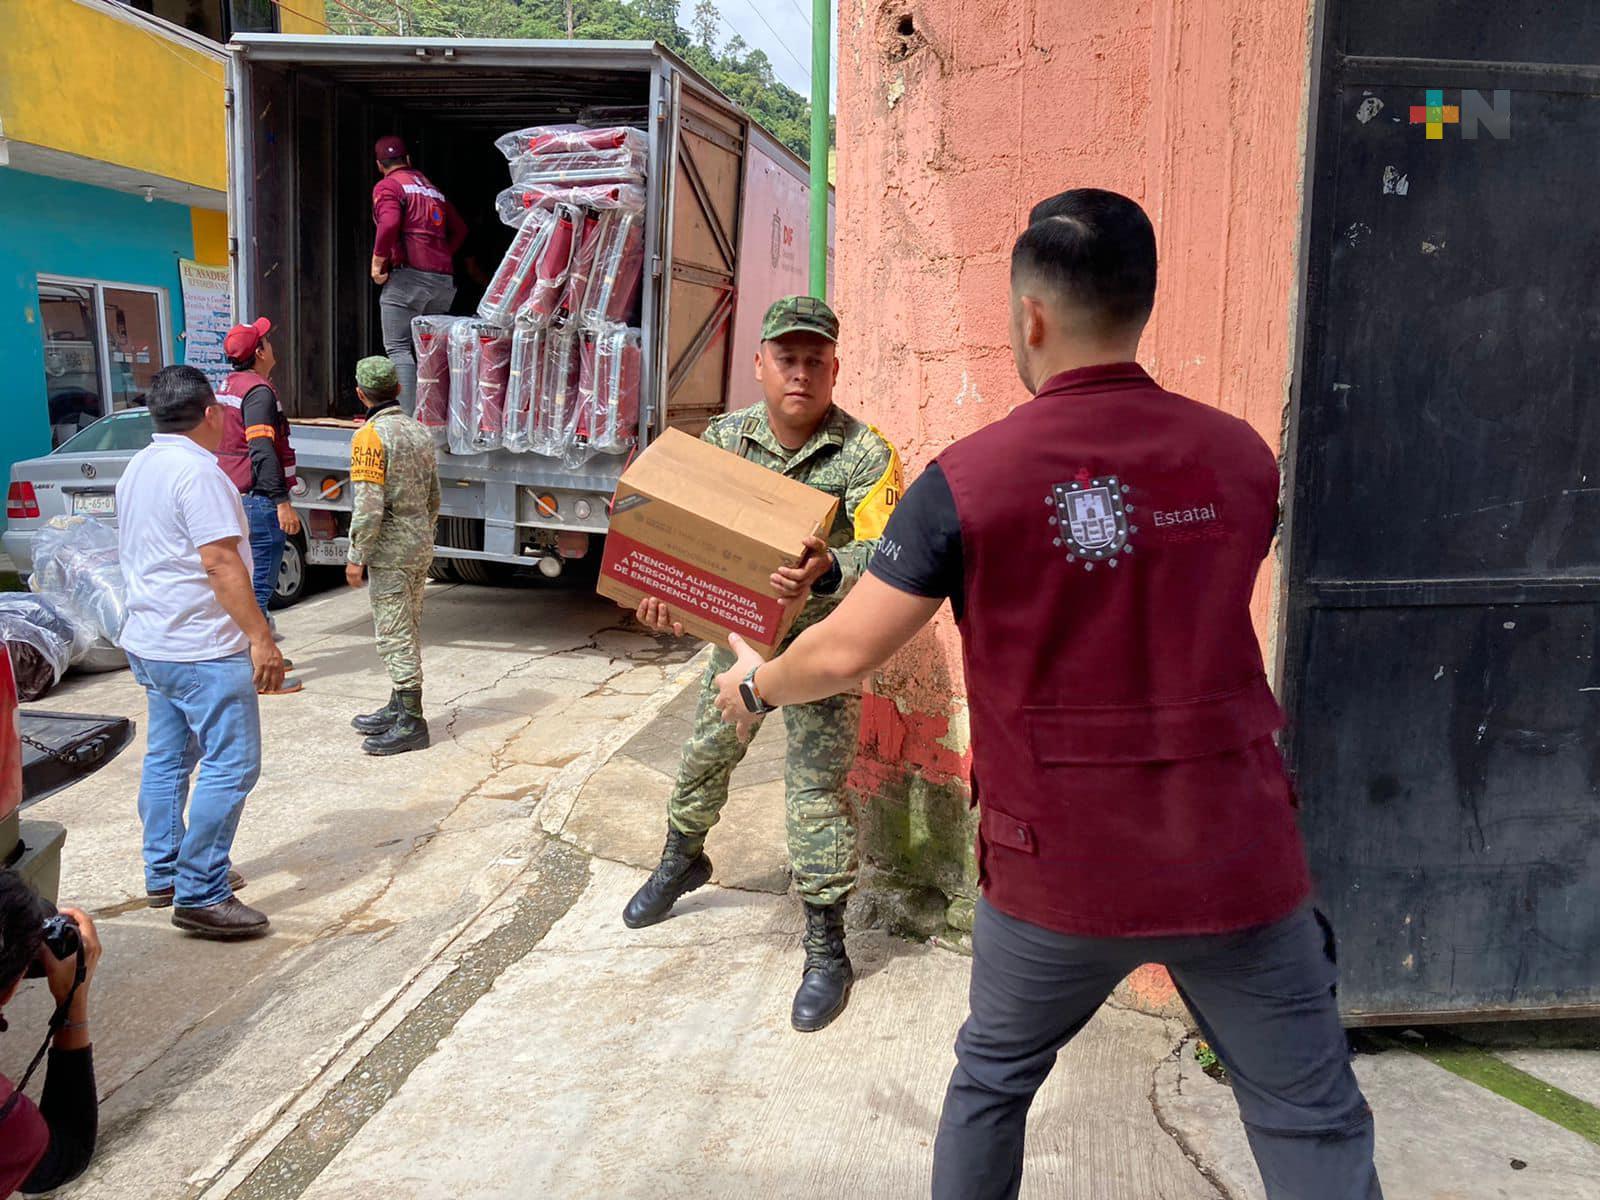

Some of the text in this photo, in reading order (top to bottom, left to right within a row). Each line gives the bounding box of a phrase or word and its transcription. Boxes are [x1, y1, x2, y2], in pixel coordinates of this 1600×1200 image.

[354, 447, 383, 459] PLAN
[1153, 503, 1216, 526] Estatal
[614, 563, 629, 575] DE
[630, 571, 698, 606] EMERGENCIA
[700, 601, 709, 610] O
[711, 606, 766, 634] DESASTRE
[622, 557, 629, 566] A
[632, 561, 688, 591] PERSONAS
[690, 586, 705, 598] EN
[706, 594, 763, 622] SITUACIÓN
[630, 550, 684, 578] ATENCIÓN
[685, 574, 758, 609] ALIMENTARIA
